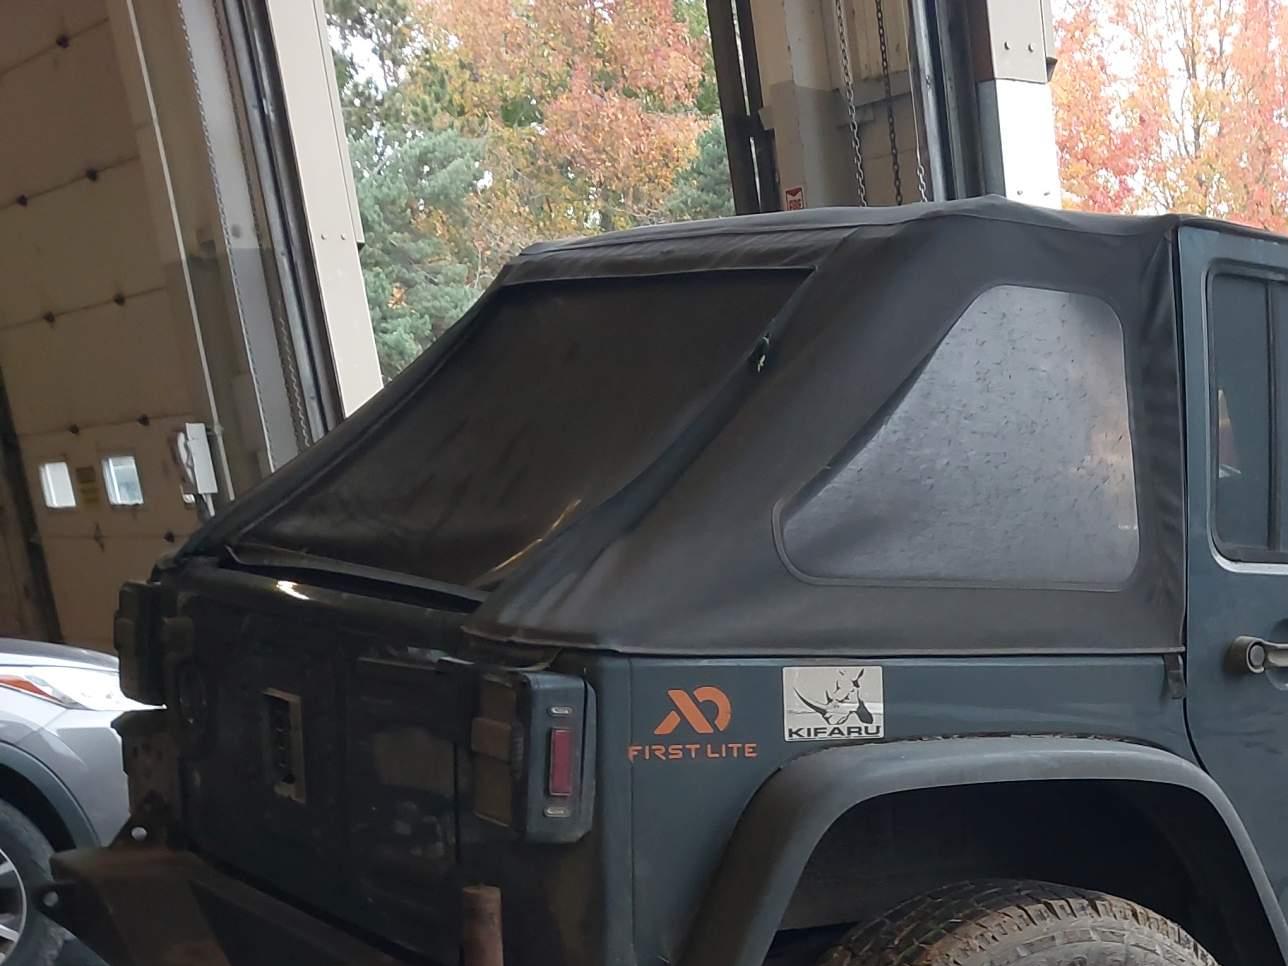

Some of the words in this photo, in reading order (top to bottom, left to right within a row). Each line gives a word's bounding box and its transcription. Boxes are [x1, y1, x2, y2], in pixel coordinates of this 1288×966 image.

[788, 725, 881, 738] KIFARU
[628, 744, 700, 763] FIRST
[706, 743, 758, 759] LITE
